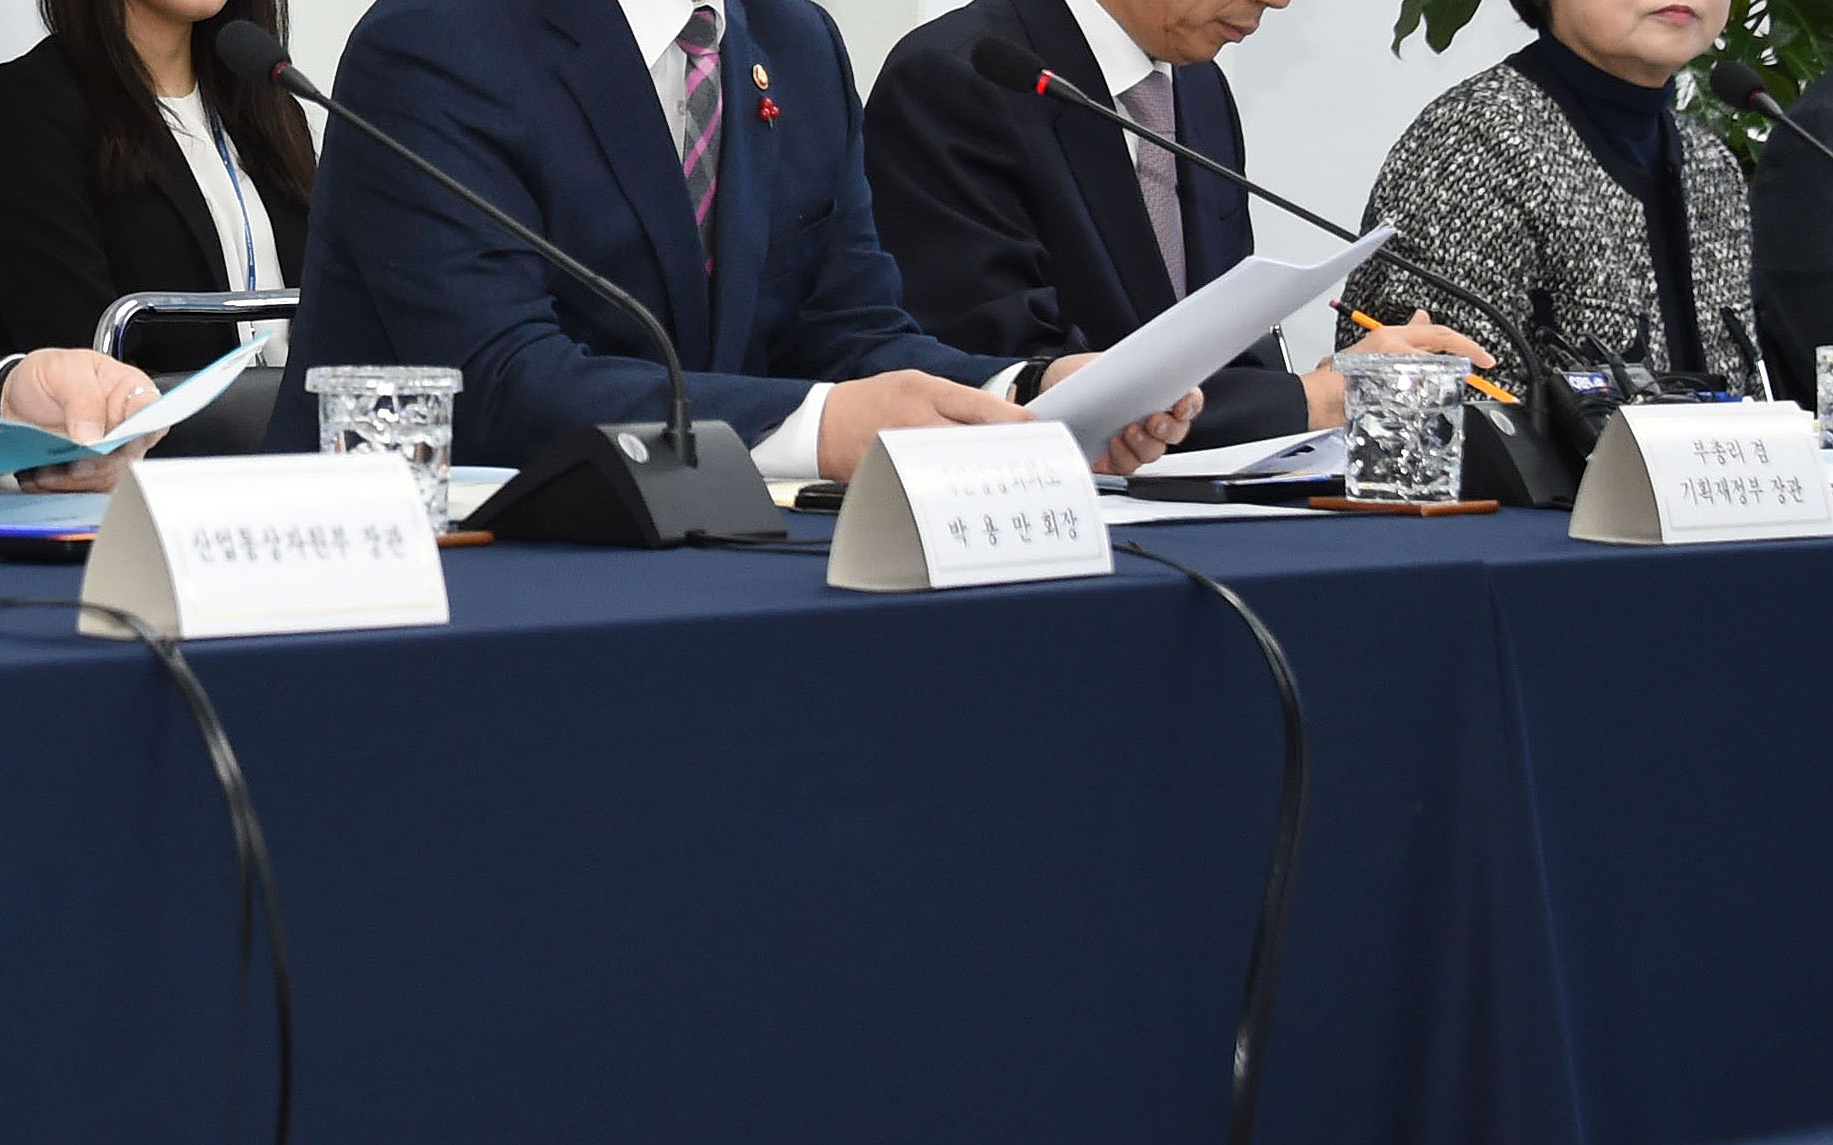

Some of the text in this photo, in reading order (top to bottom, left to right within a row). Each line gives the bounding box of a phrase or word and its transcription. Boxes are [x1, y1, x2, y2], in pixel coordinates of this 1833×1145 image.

[1693, 439, 1769, 465] 부총리 겸
[1680, 476, 1764, 505] 기획재정부
[1771, 475, 1804, 504] 장관
[193, 523, 407, 563] 산업통상자원부 장관
[948, 516, 968, 548] 박
[982, 514, 999, 546] 용
[1012, 510, 1032, 543] 만
